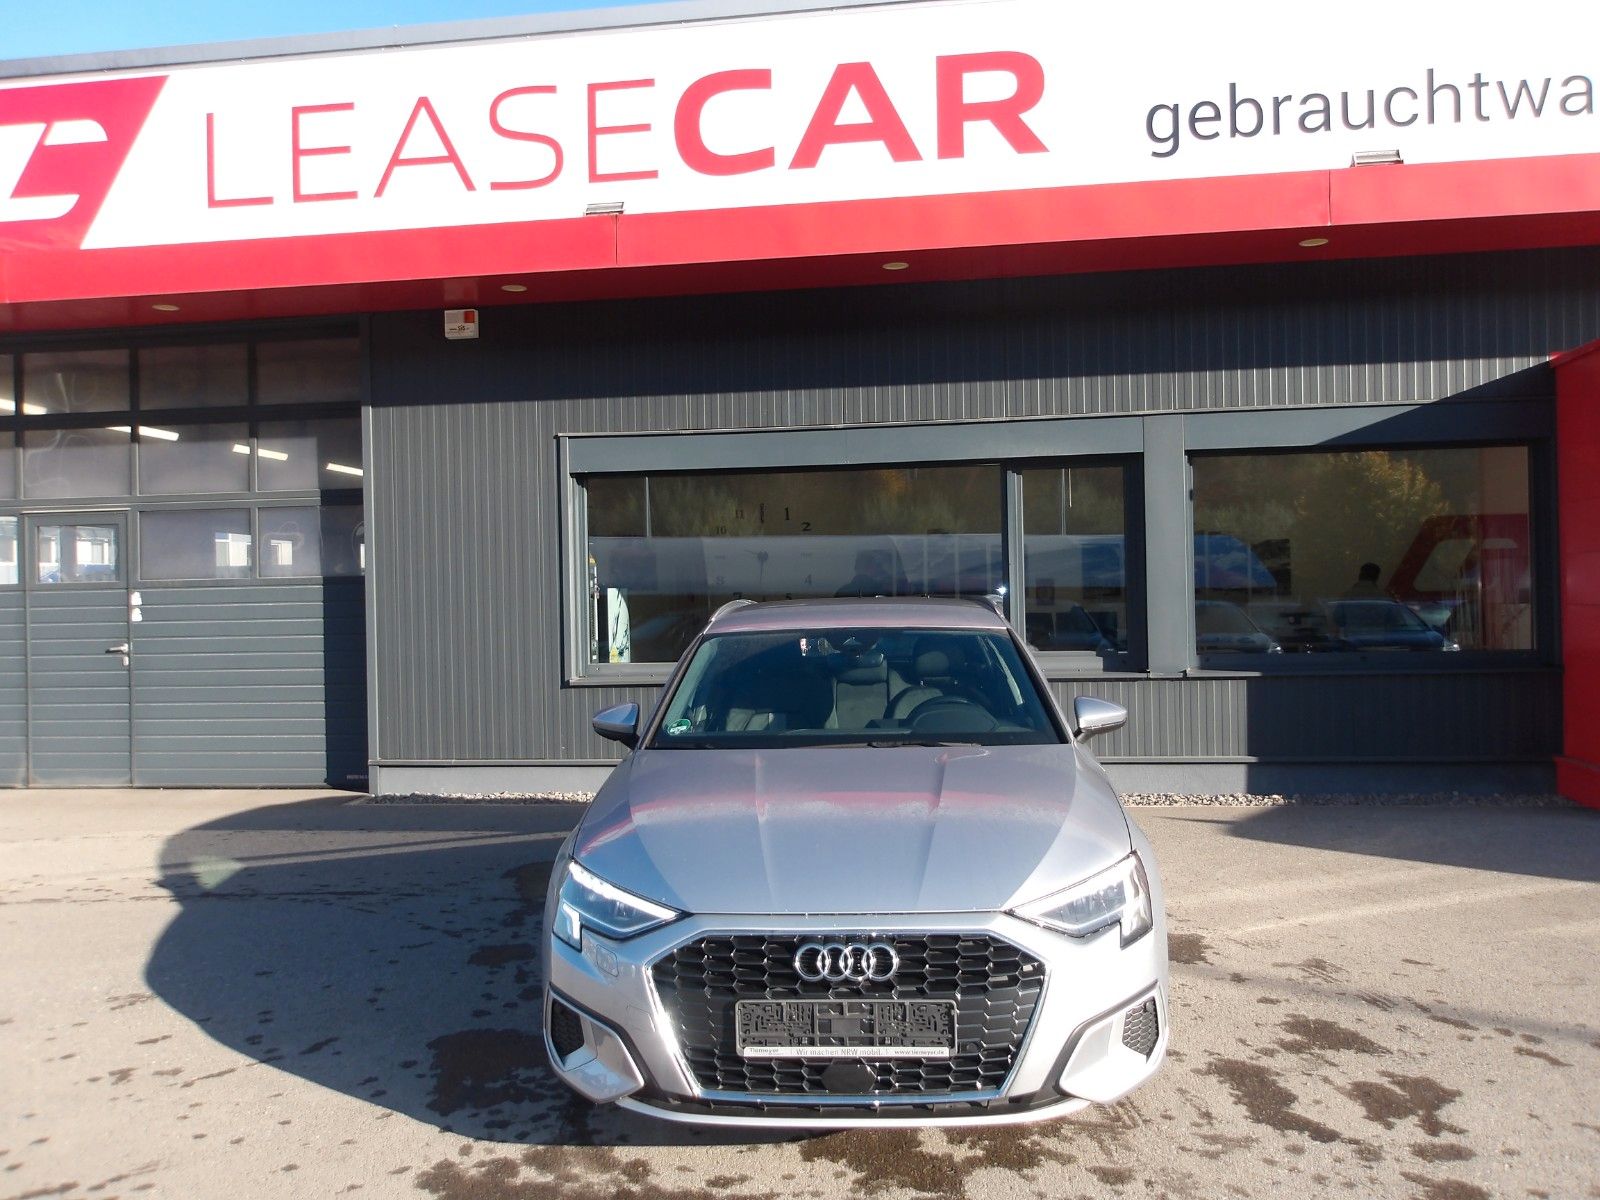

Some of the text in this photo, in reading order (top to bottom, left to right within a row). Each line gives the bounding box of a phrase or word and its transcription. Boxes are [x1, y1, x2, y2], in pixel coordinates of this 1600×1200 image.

[206, 50, 1048, 209] LEASECAR
[1145, 67, 1594, 158] gebrauchtwa
[801, 521, 811, 531] 2
